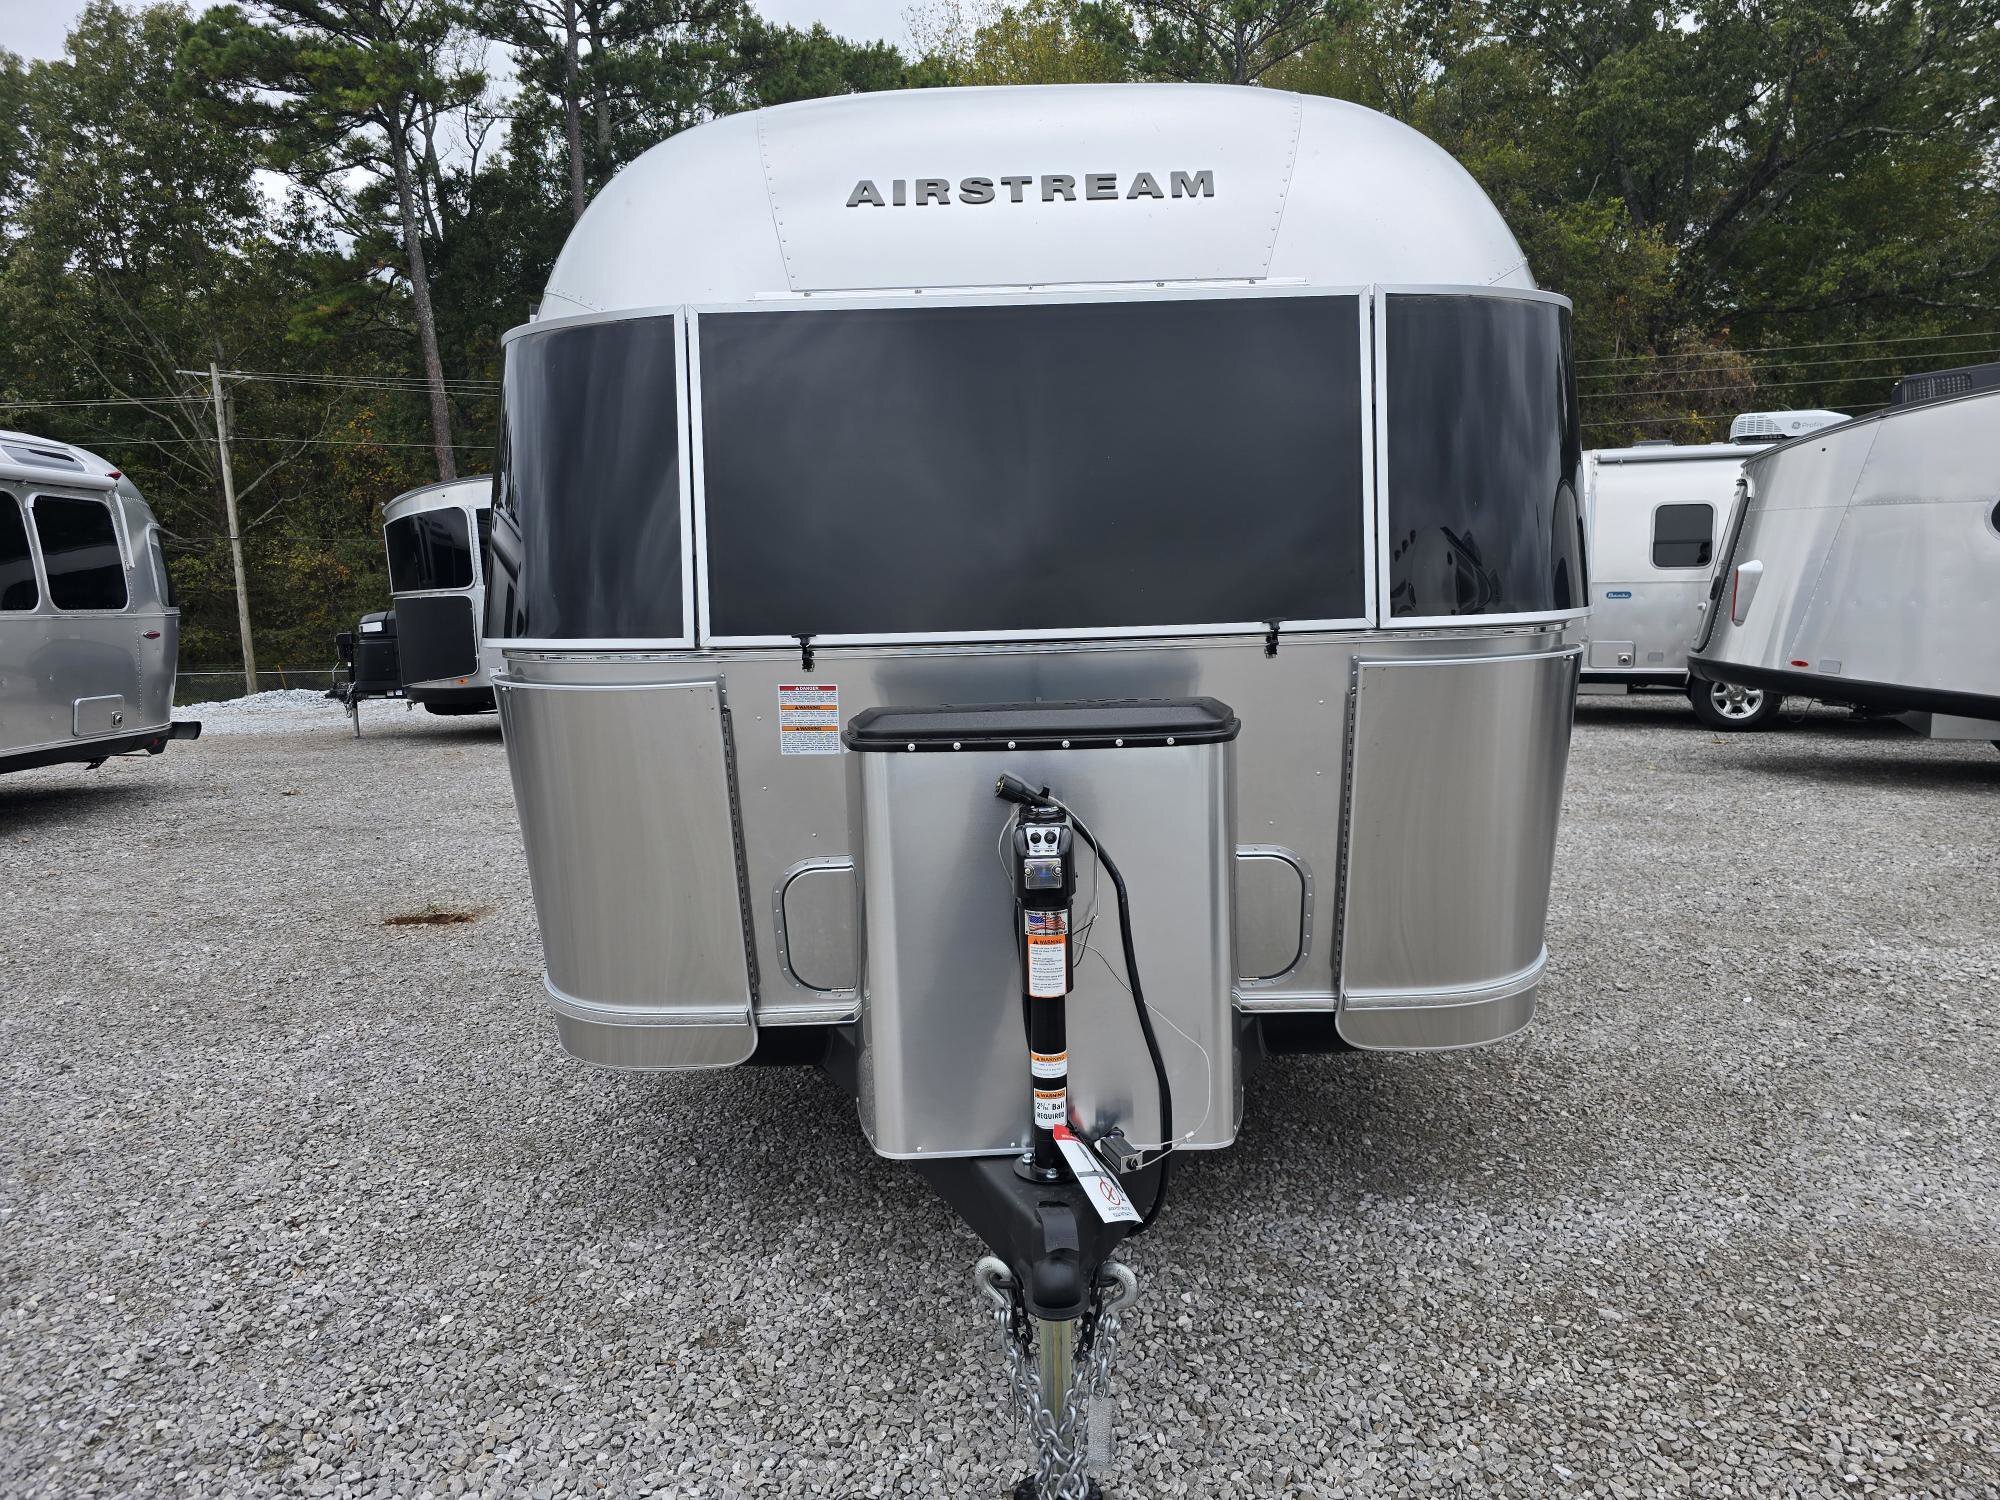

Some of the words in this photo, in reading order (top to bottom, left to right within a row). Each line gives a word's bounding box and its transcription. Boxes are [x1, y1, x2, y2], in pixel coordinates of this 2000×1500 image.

[846, 169, 1215, 208] AIRSTREAM
[1041, 1054, 1065, 1062] WARNING
[1052, 1101, 1065, 1111] Ball
[1036, 1111, 1065, 1120] REQUIRED
